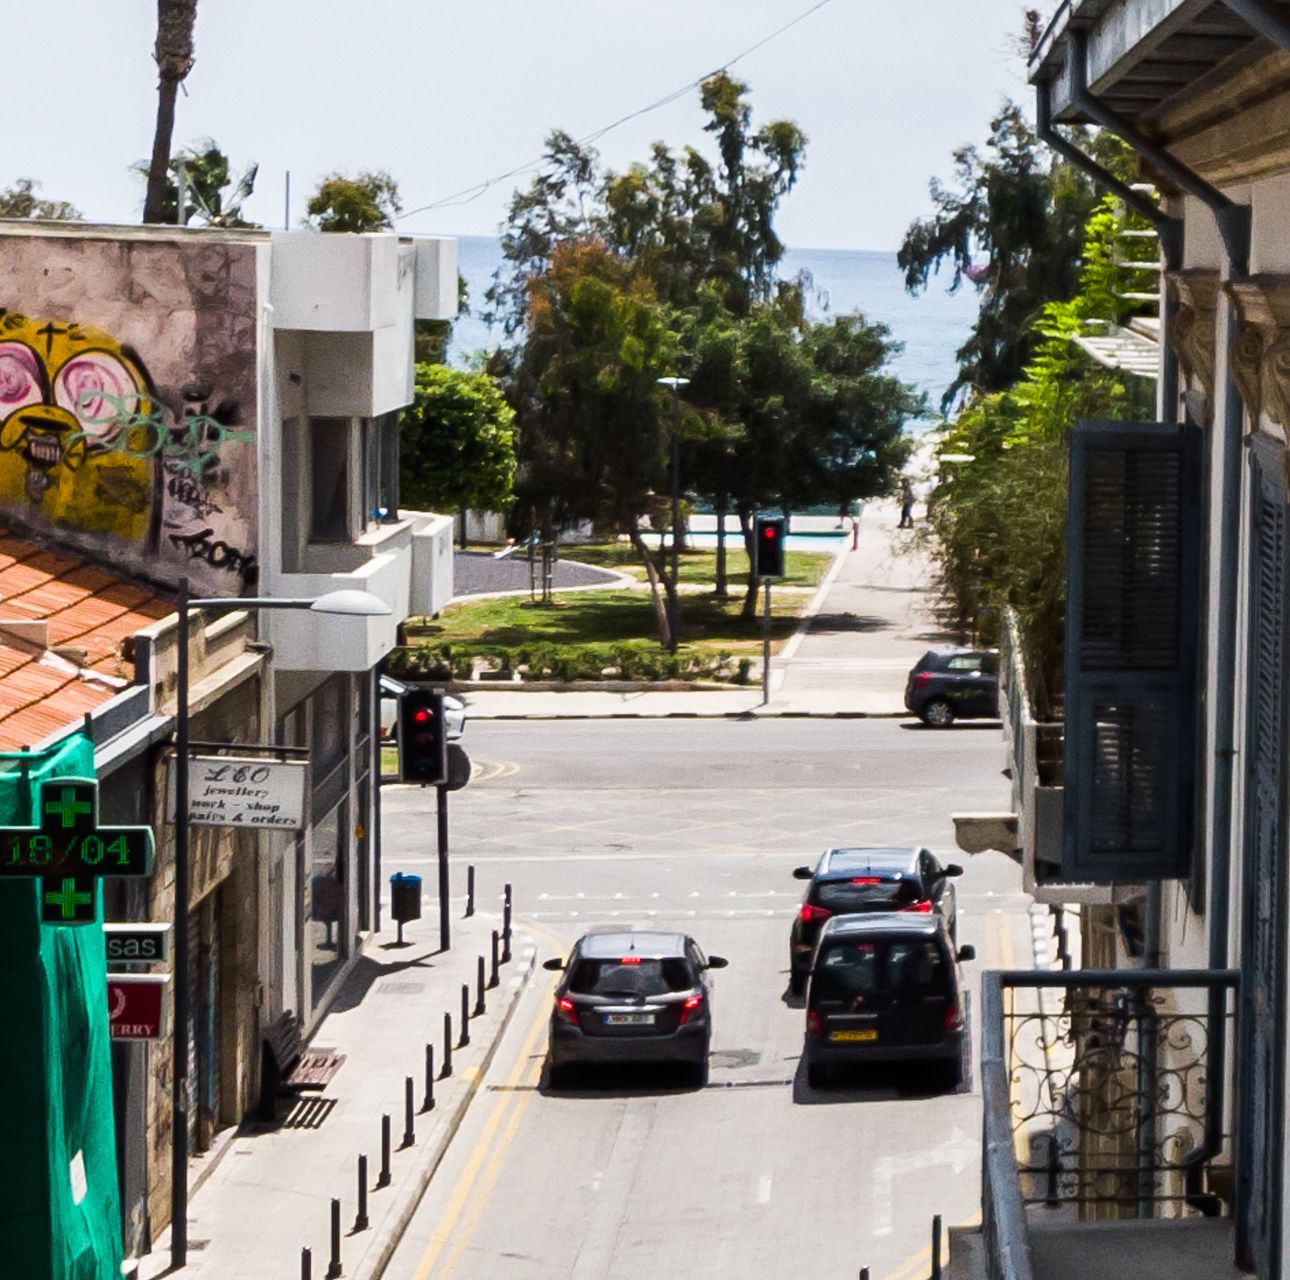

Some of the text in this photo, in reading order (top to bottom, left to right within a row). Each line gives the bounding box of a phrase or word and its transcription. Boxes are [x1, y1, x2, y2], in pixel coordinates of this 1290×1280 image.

[204, 764, 271, 783] LEO
[246, 802, 280, 813] shop
[251, 815, 297, 825] orders
